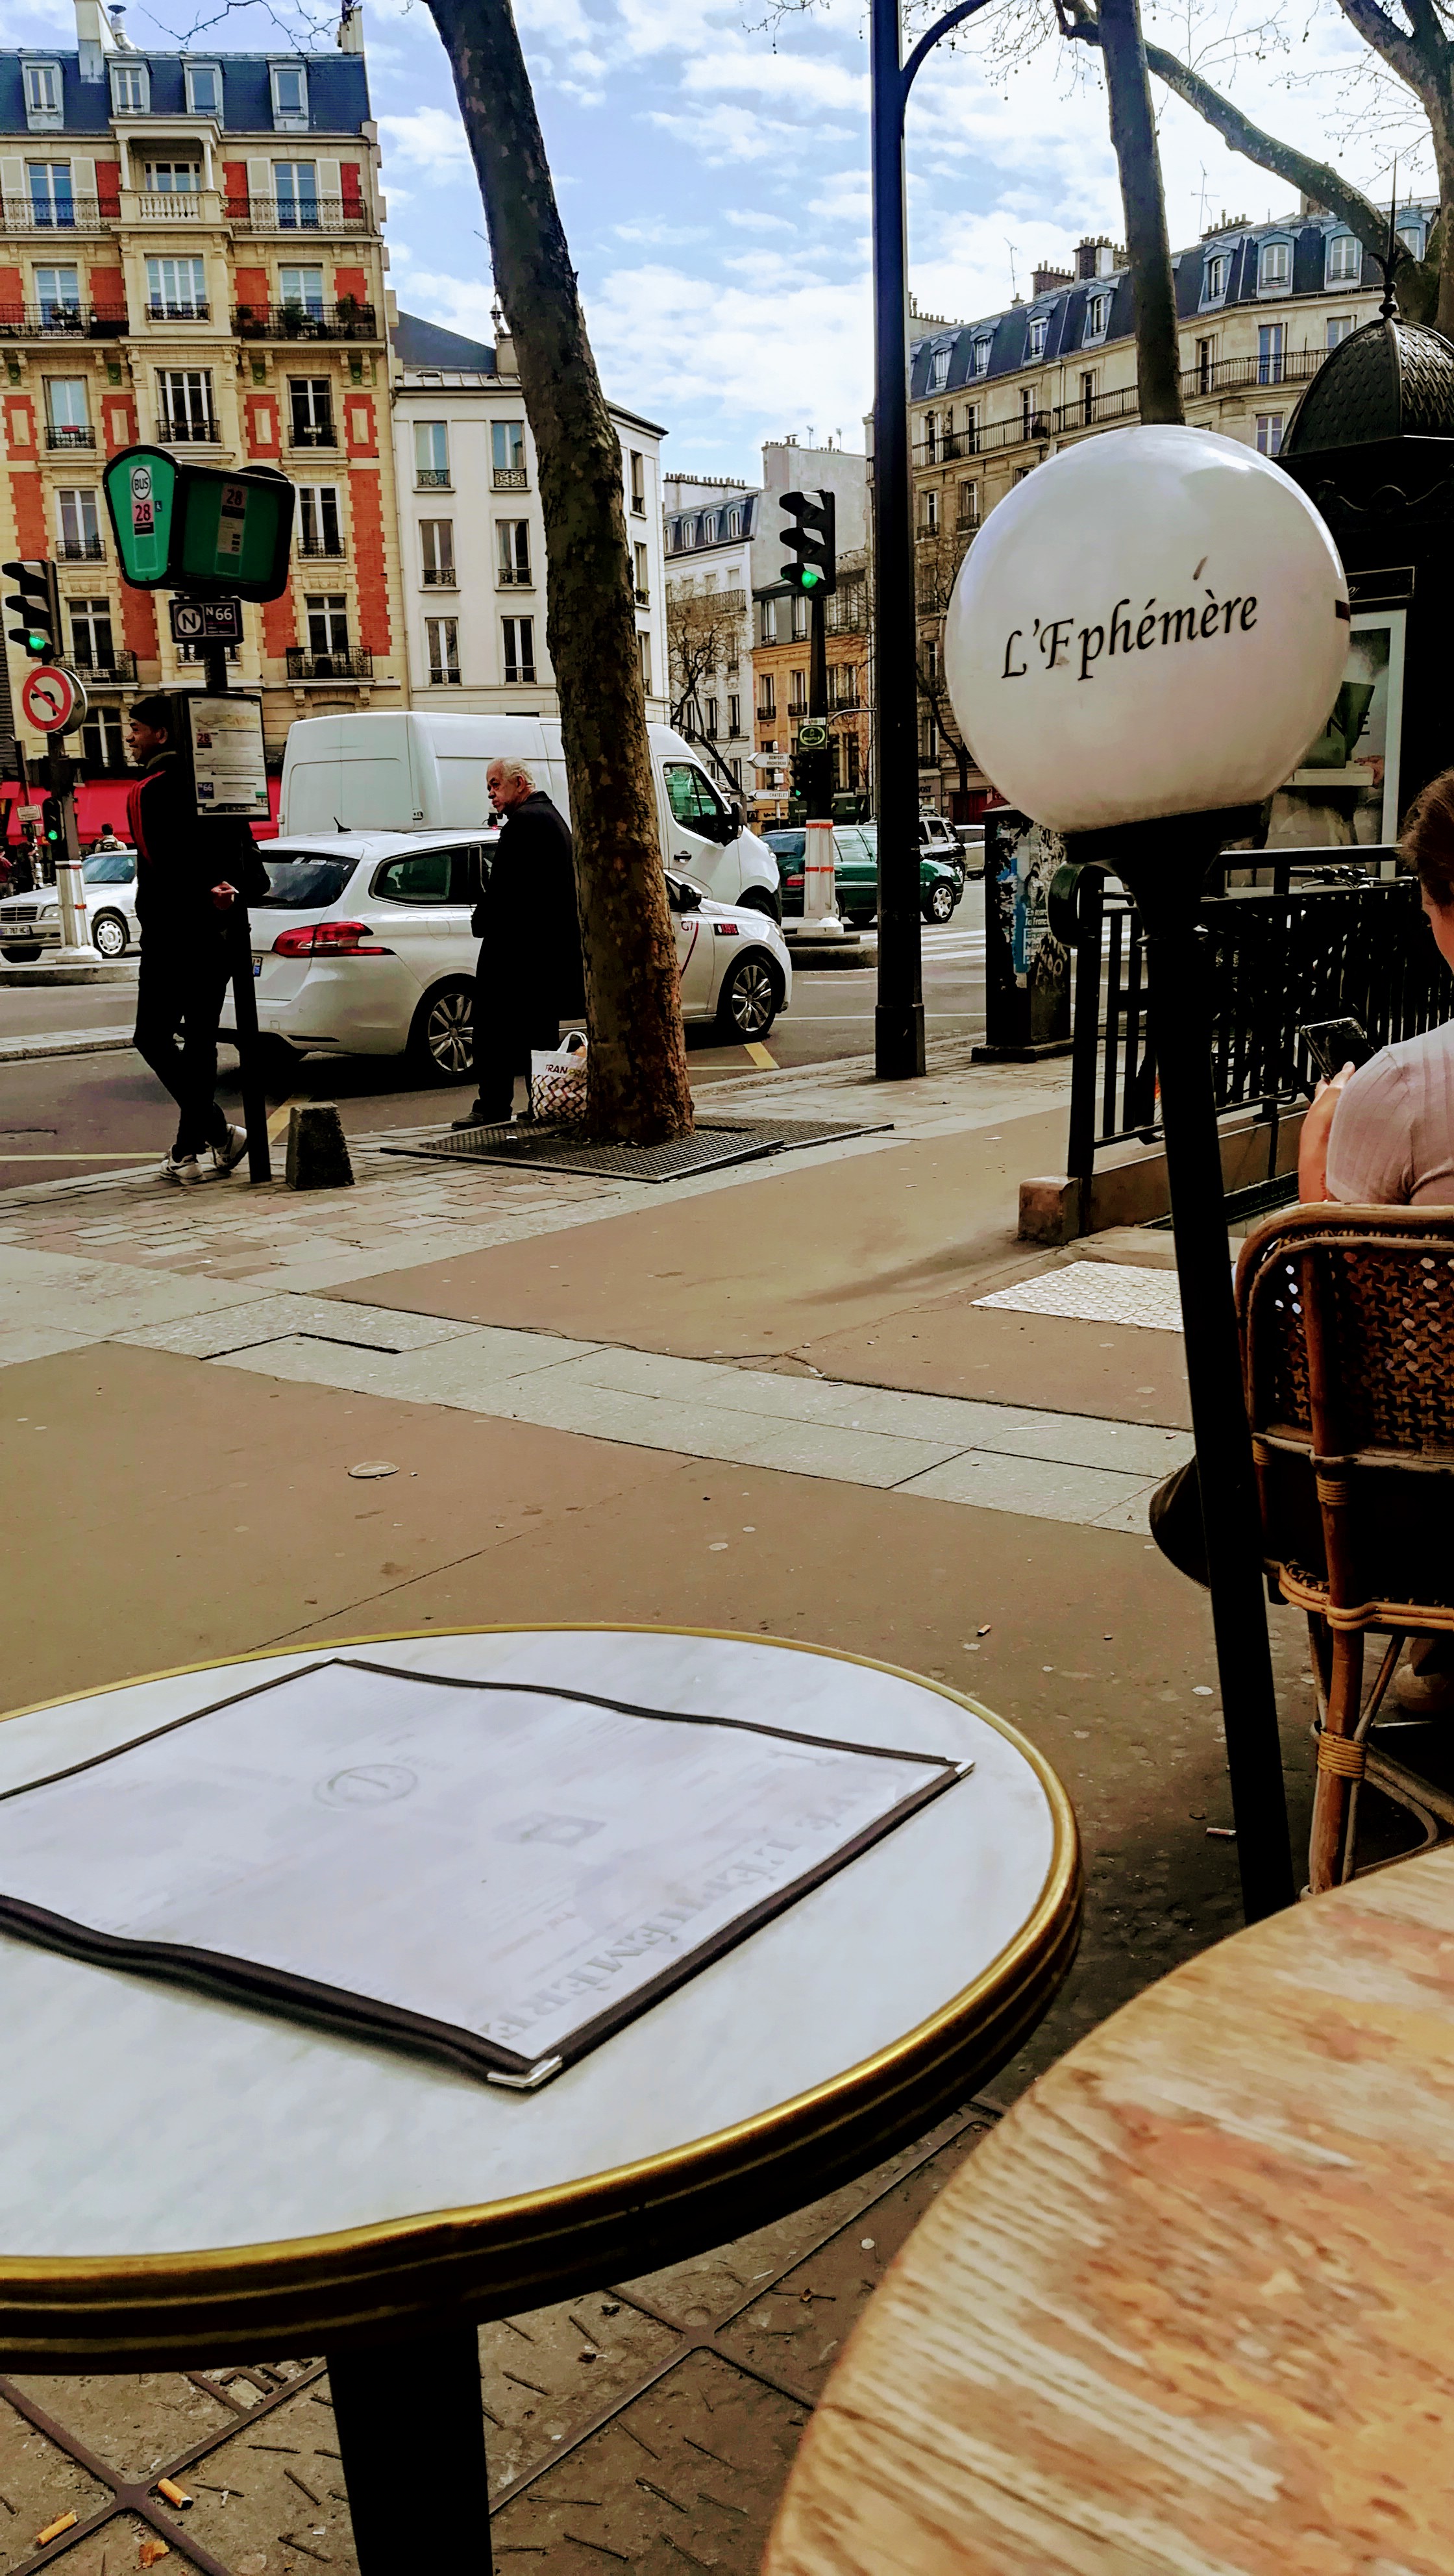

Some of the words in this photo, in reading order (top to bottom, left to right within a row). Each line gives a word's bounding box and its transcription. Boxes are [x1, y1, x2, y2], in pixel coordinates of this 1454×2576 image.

[134, 477, 149, 490] BUS
[227, 488, 243, 506] 28
[135, 504, 151, 522] 28
